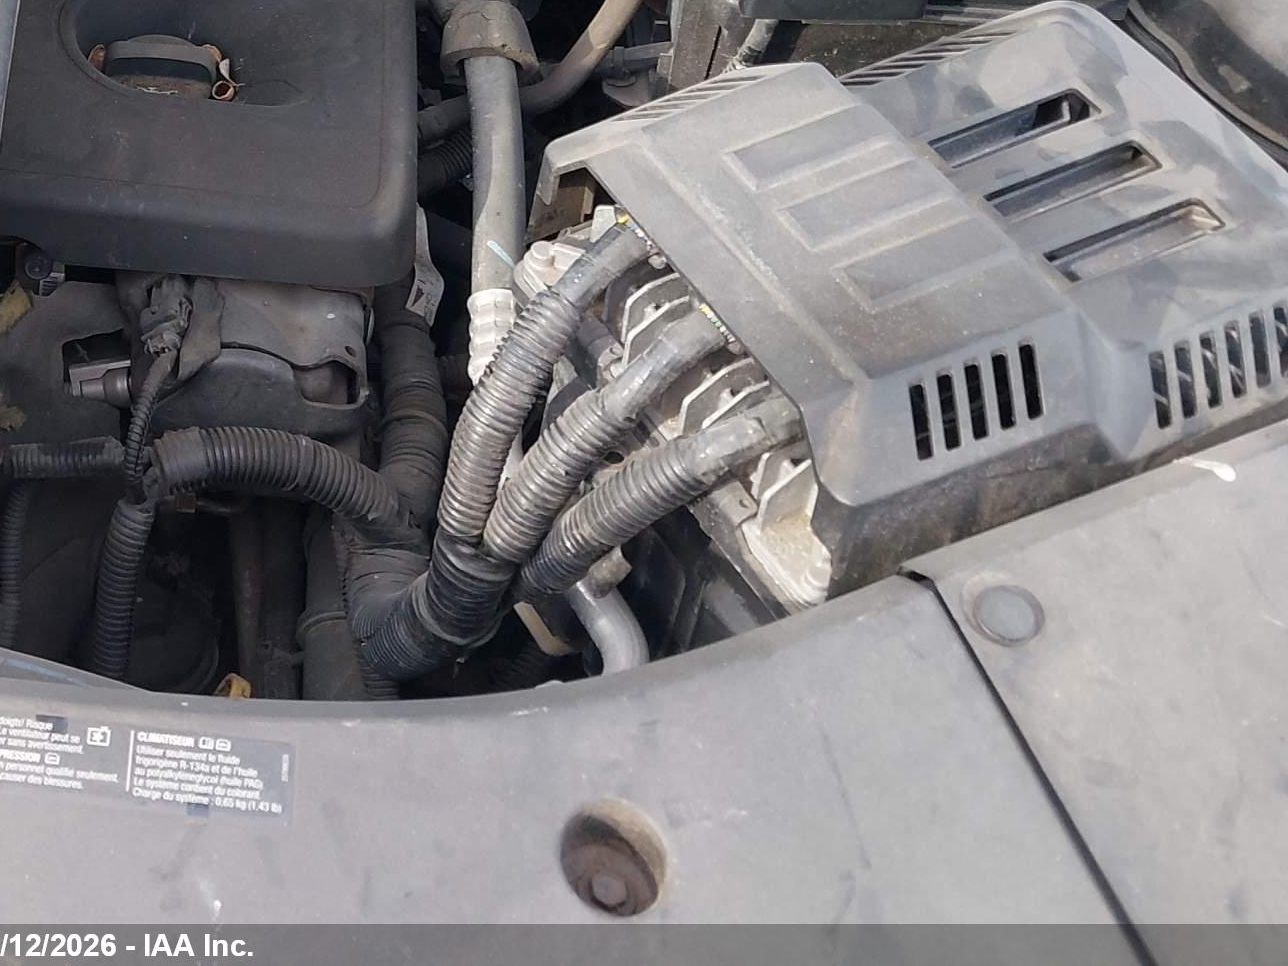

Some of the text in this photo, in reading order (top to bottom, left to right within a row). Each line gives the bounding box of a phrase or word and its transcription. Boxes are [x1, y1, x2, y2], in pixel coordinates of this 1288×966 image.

[26, 719, 54, 731] Risque
[7, 738, 26, 747] sans
[8, 728, 50, 739] ventilateur
[50, 733, 70, 743] peut
[70, 736, 80, 744] se
[136, 732, 195, 748] CLIMATISEUR
[136, 746, 241, 765] Utiliser seulement le fluide
[5, 763, 45, 774] personnel
[134, 767, 146, 776] au
[180, 761, 210, 773] R-134a
[211, 765, 220, 774] et
[220, 766, 232, 775] de
[27, 775, 44, 784] des
[134, 778, 145, 786] Le
[180, 783, 214, 794] contient
[214, 786, 226, 796] du
[132, 788, 162, 801] Charge
[162, 791, 175, 801] du
[235, 800, 246, 811] kg
